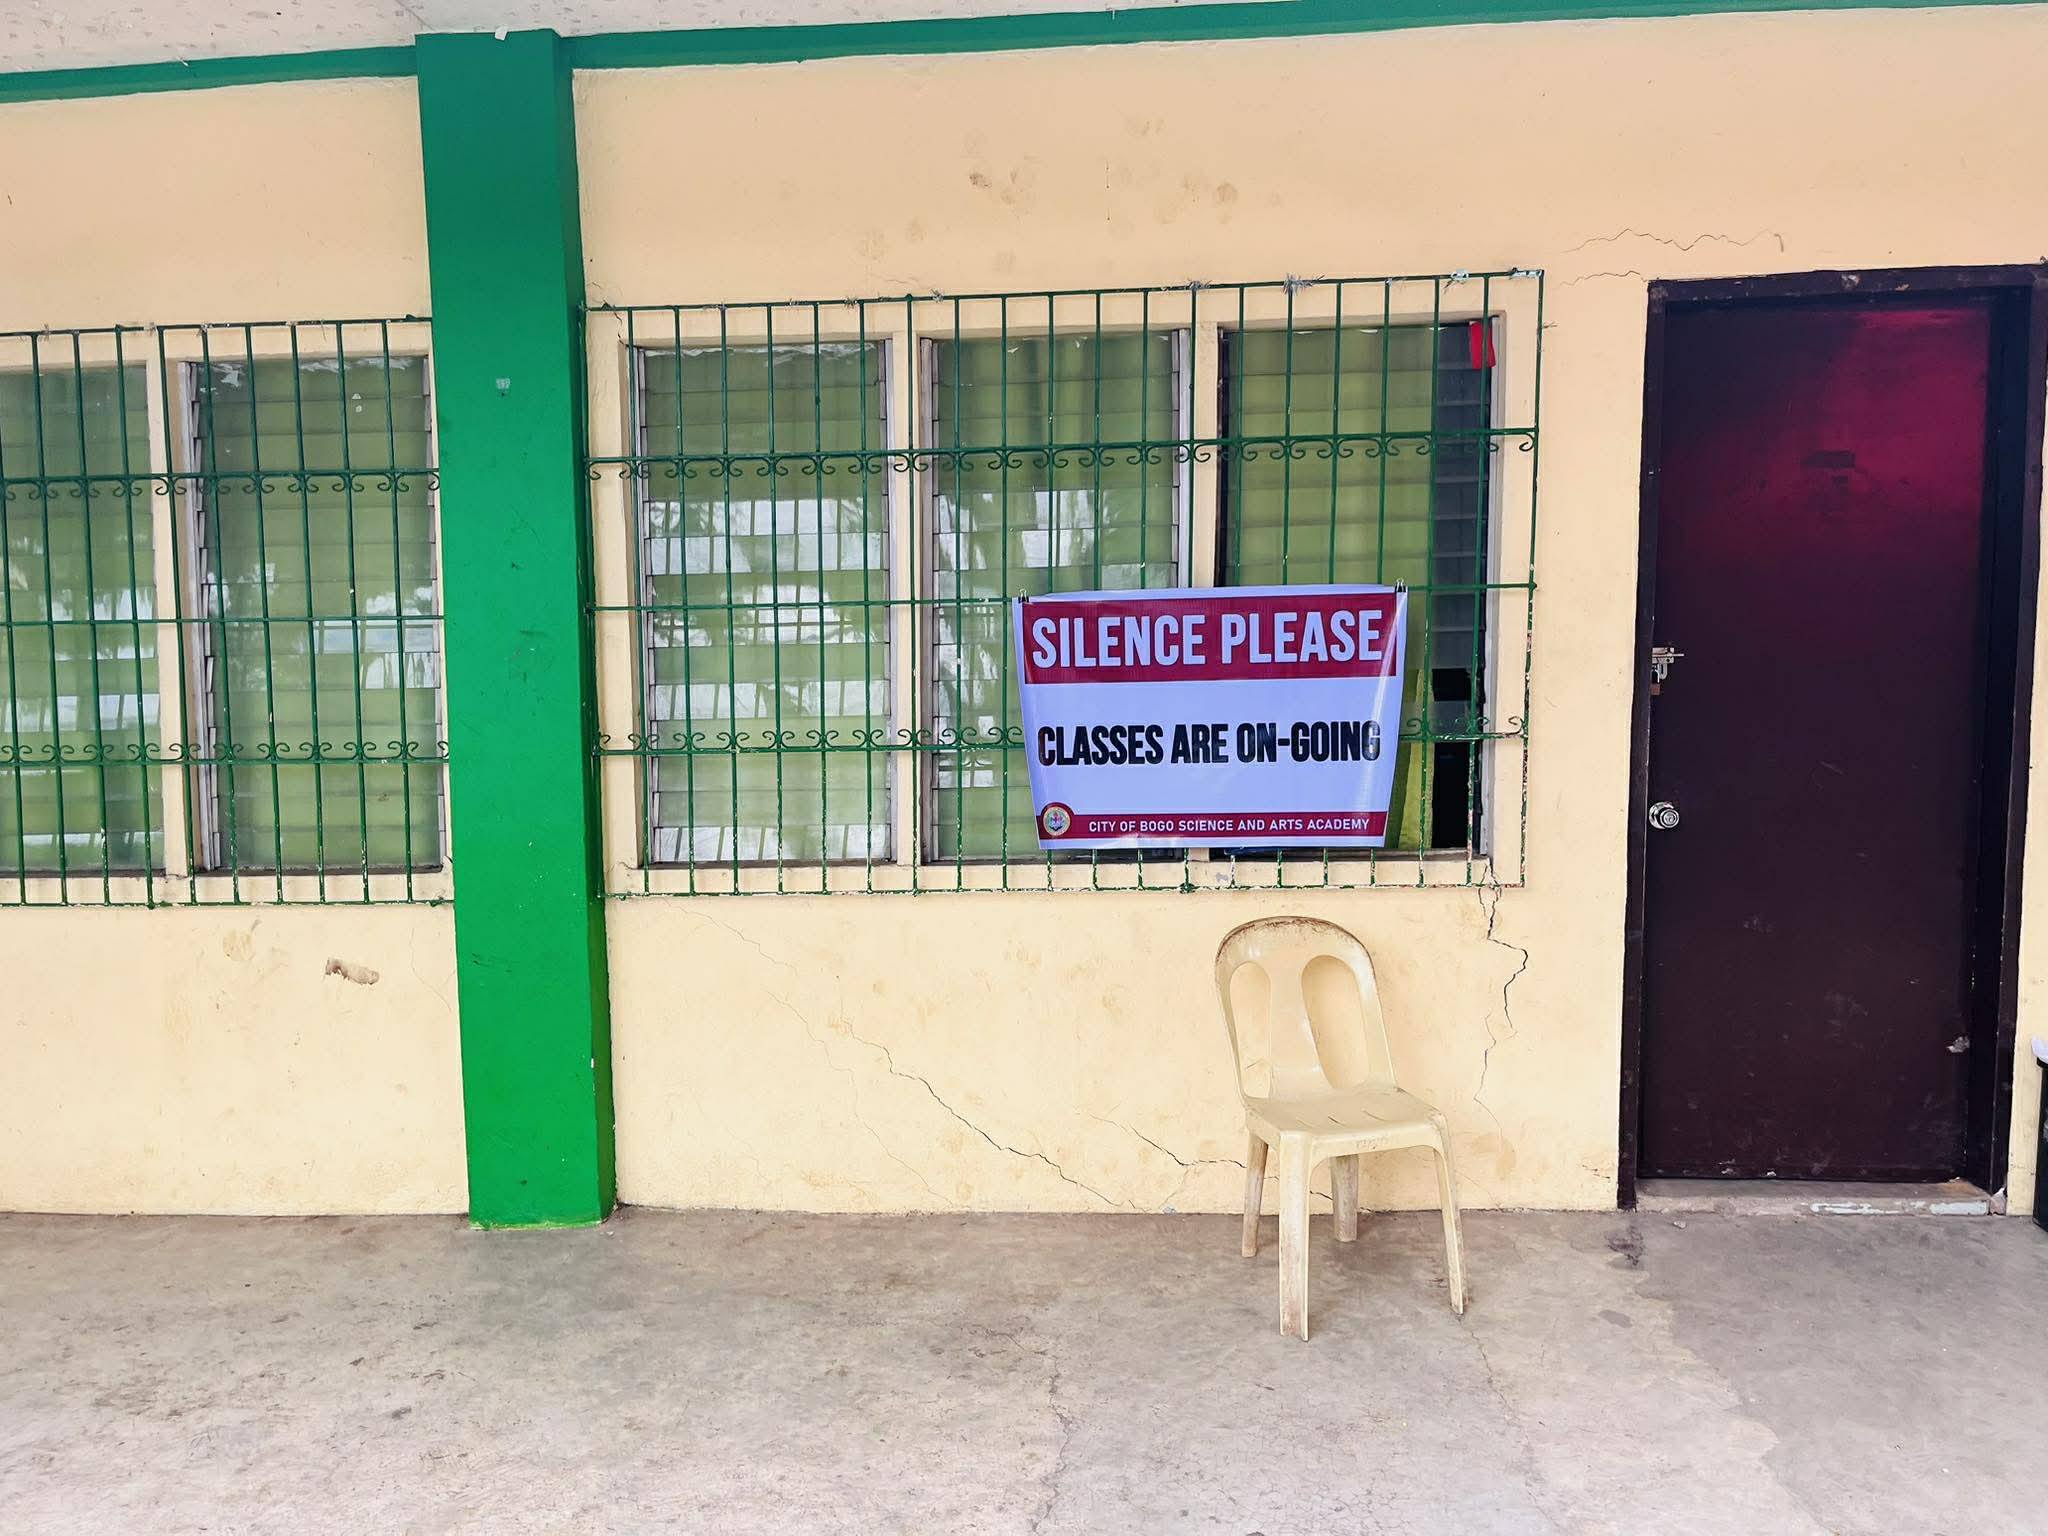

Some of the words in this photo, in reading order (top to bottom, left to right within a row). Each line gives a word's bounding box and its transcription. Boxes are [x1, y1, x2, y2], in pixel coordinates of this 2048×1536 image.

[1031, 613, 1206, 669] SILENCE
[1221, 609, 1383, 665] PLEASE
[1037, 724, 1163, 767] CLASSES
[1171, 722, 1229, 764] ARE
[1236, 720, 1381, 763] ON-GOING
[1088, 820, 1116, 832] CITY
[1119, 820, 1136, 832] OF
[1140, 820, 1175, 832] BOGO
[1178, 819, 1234, 831] SCIENCE
[1237, 819, 1266, 831] AND
[1269, 818, 1303, 831] ARTS
[1306, 818, 1370, 830] ACADEMY
